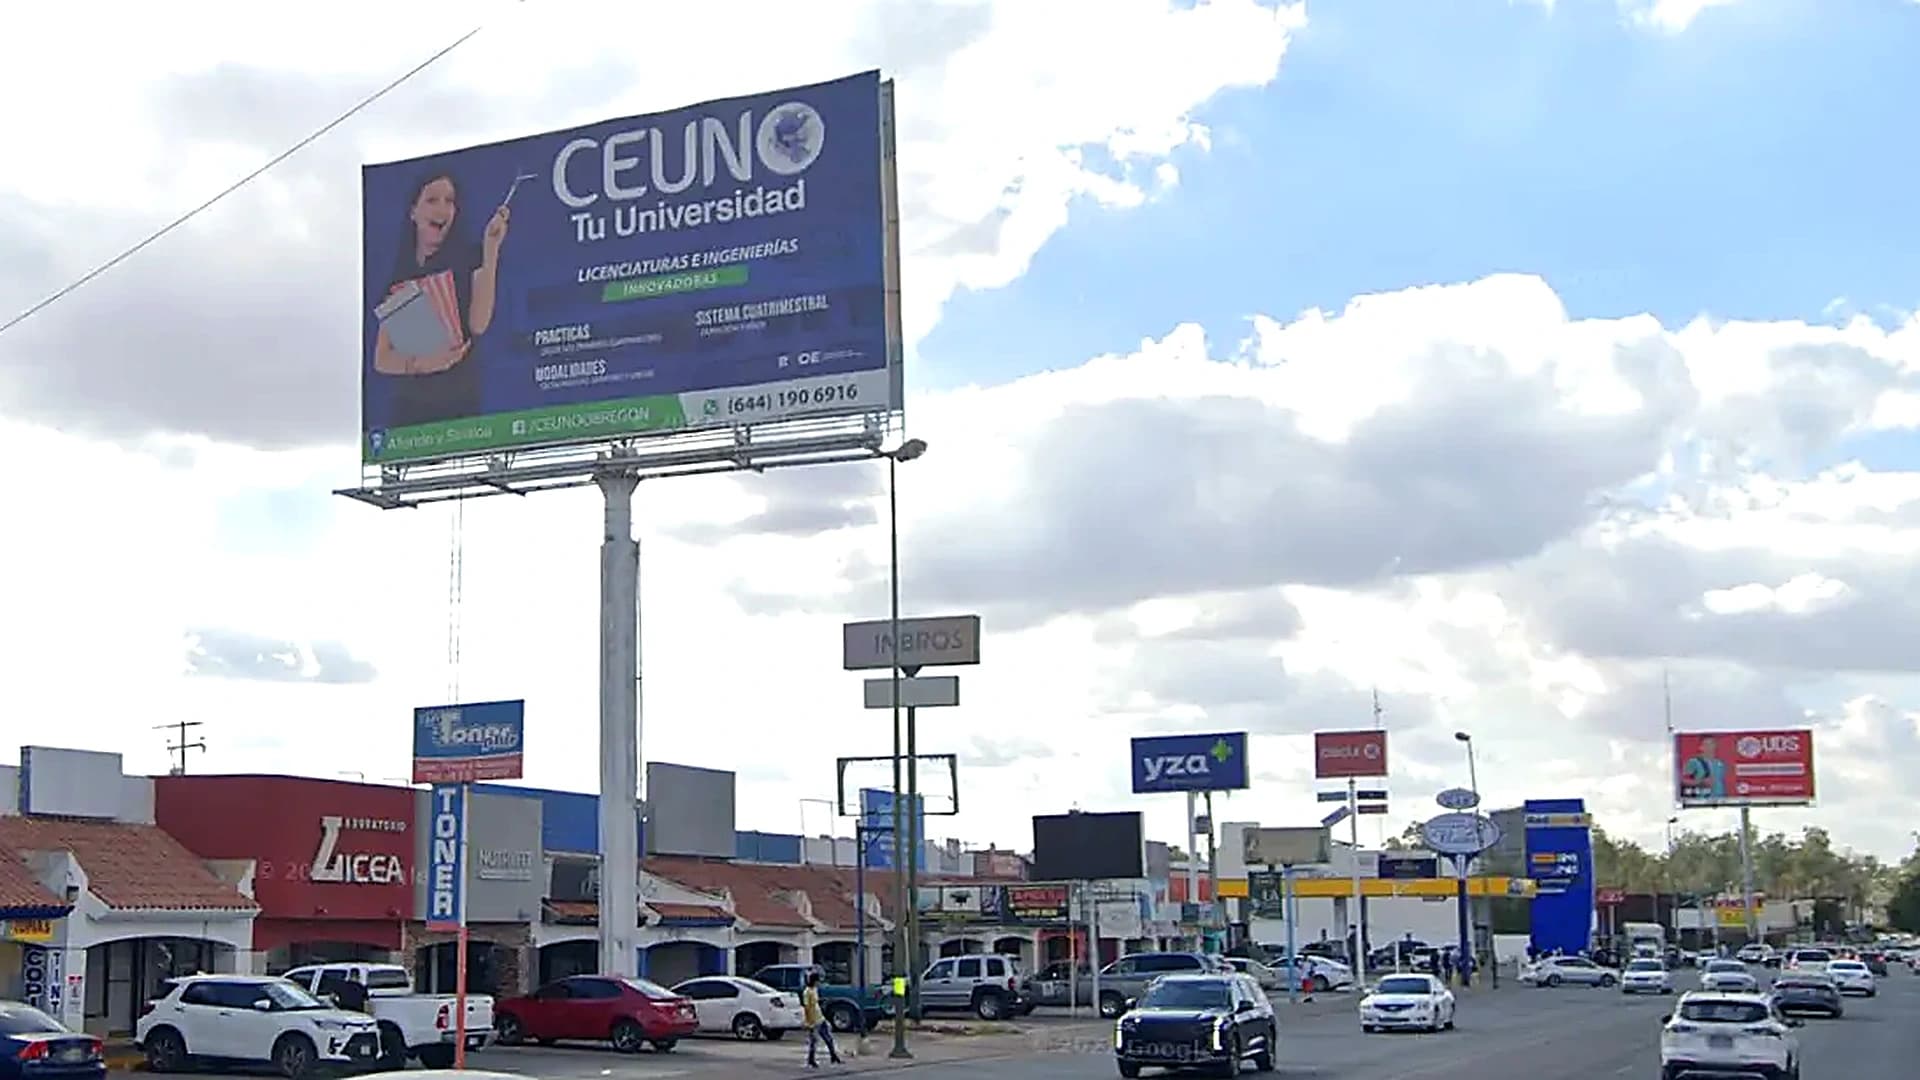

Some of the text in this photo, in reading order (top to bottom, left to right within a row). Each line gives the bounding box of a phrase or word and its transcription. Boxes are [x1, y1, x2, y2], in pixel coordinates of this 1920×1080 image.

[553, 102, 825, 207] CEUNO
[571, 179, 806, 242] Tu Universidad
[578, 237, 800, 283] LICENCIATURAS E INGENIERÍAS
[695, 306, 740, 326] SISTEMA
[728, 383, 858, 415] (644) 190 6916
[1143, 752, 1212, 782] yza
[311, 815, 405, 883] LICEA
[433, 787, 458, 917] TONER
